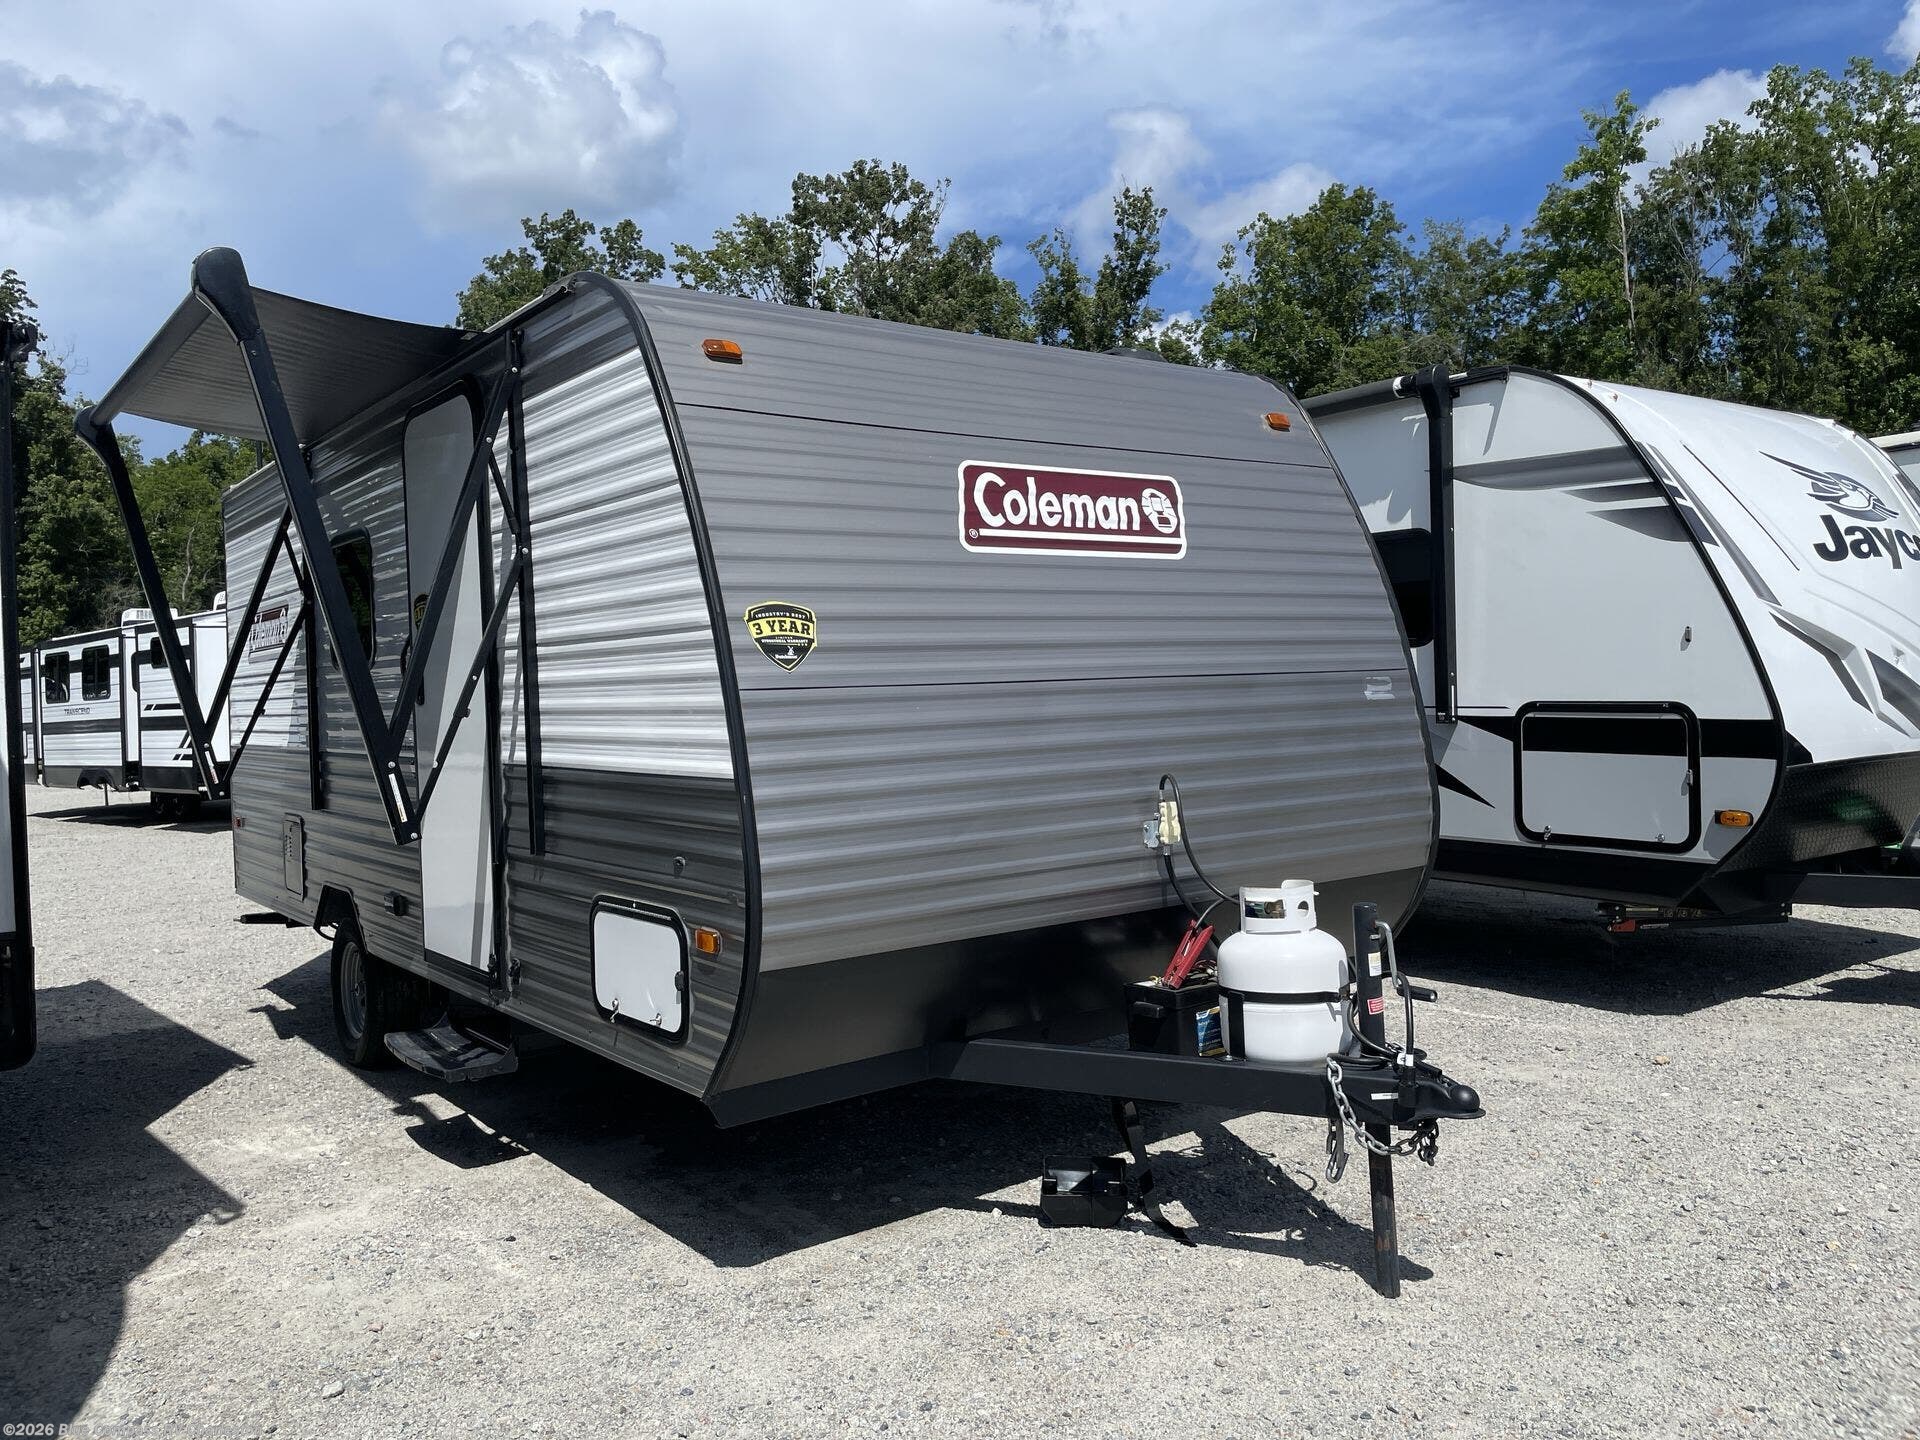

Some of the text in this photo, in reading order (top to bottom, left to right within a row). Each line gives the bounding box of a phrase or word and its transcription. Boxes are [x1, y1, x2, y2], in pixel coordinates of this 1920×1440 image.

[973, 471, 1141, 531] Coleman
[1812, 514, 1920, 570] Jayc
[752, 619, 811, 636] 3 YEAR
